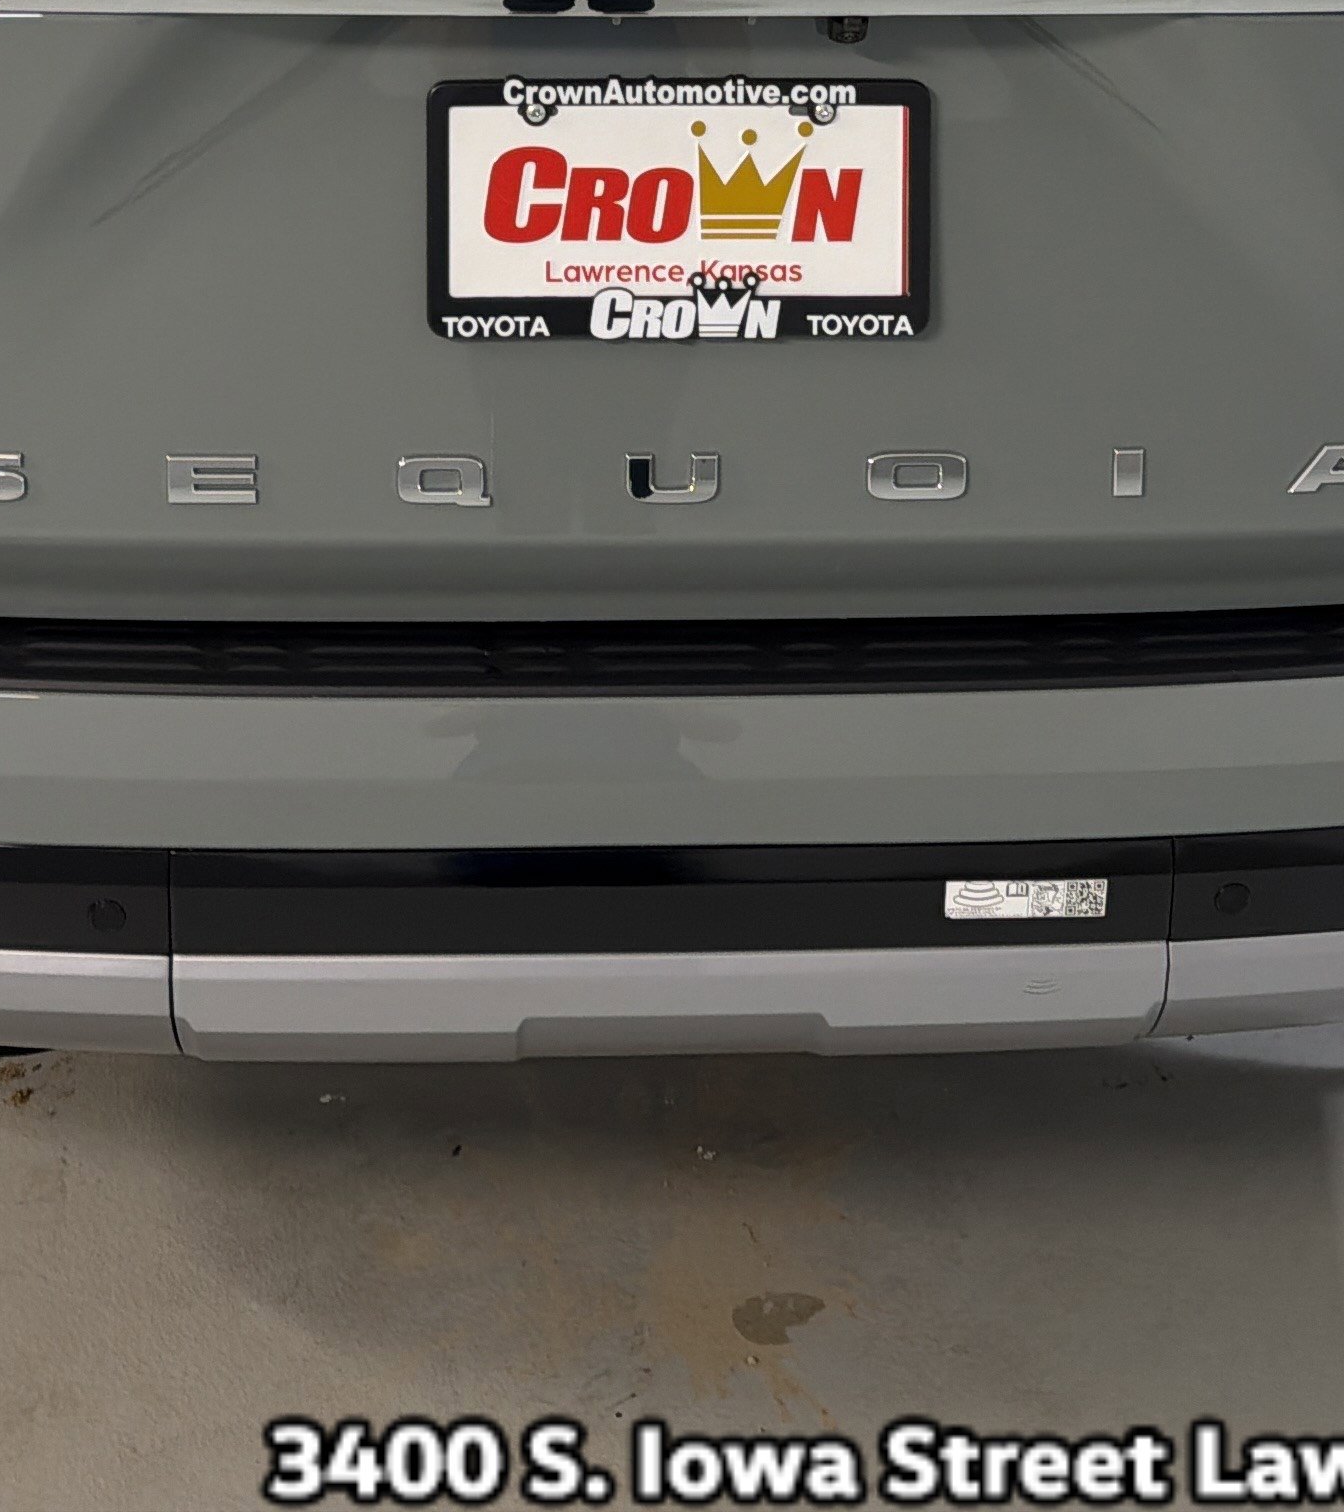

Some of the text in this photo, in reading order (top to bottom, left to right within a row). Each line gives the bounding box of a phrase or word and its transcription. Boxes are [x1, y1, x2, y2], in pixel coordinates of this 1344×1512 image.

[503, 78, 856, 106] CrownAutomotive.com
[544, 259, 803, 287] Lawrence, Kansas
[441, 315, 551, 338] TOYOTA
[805, 314, 914, 336] TOYOTA
